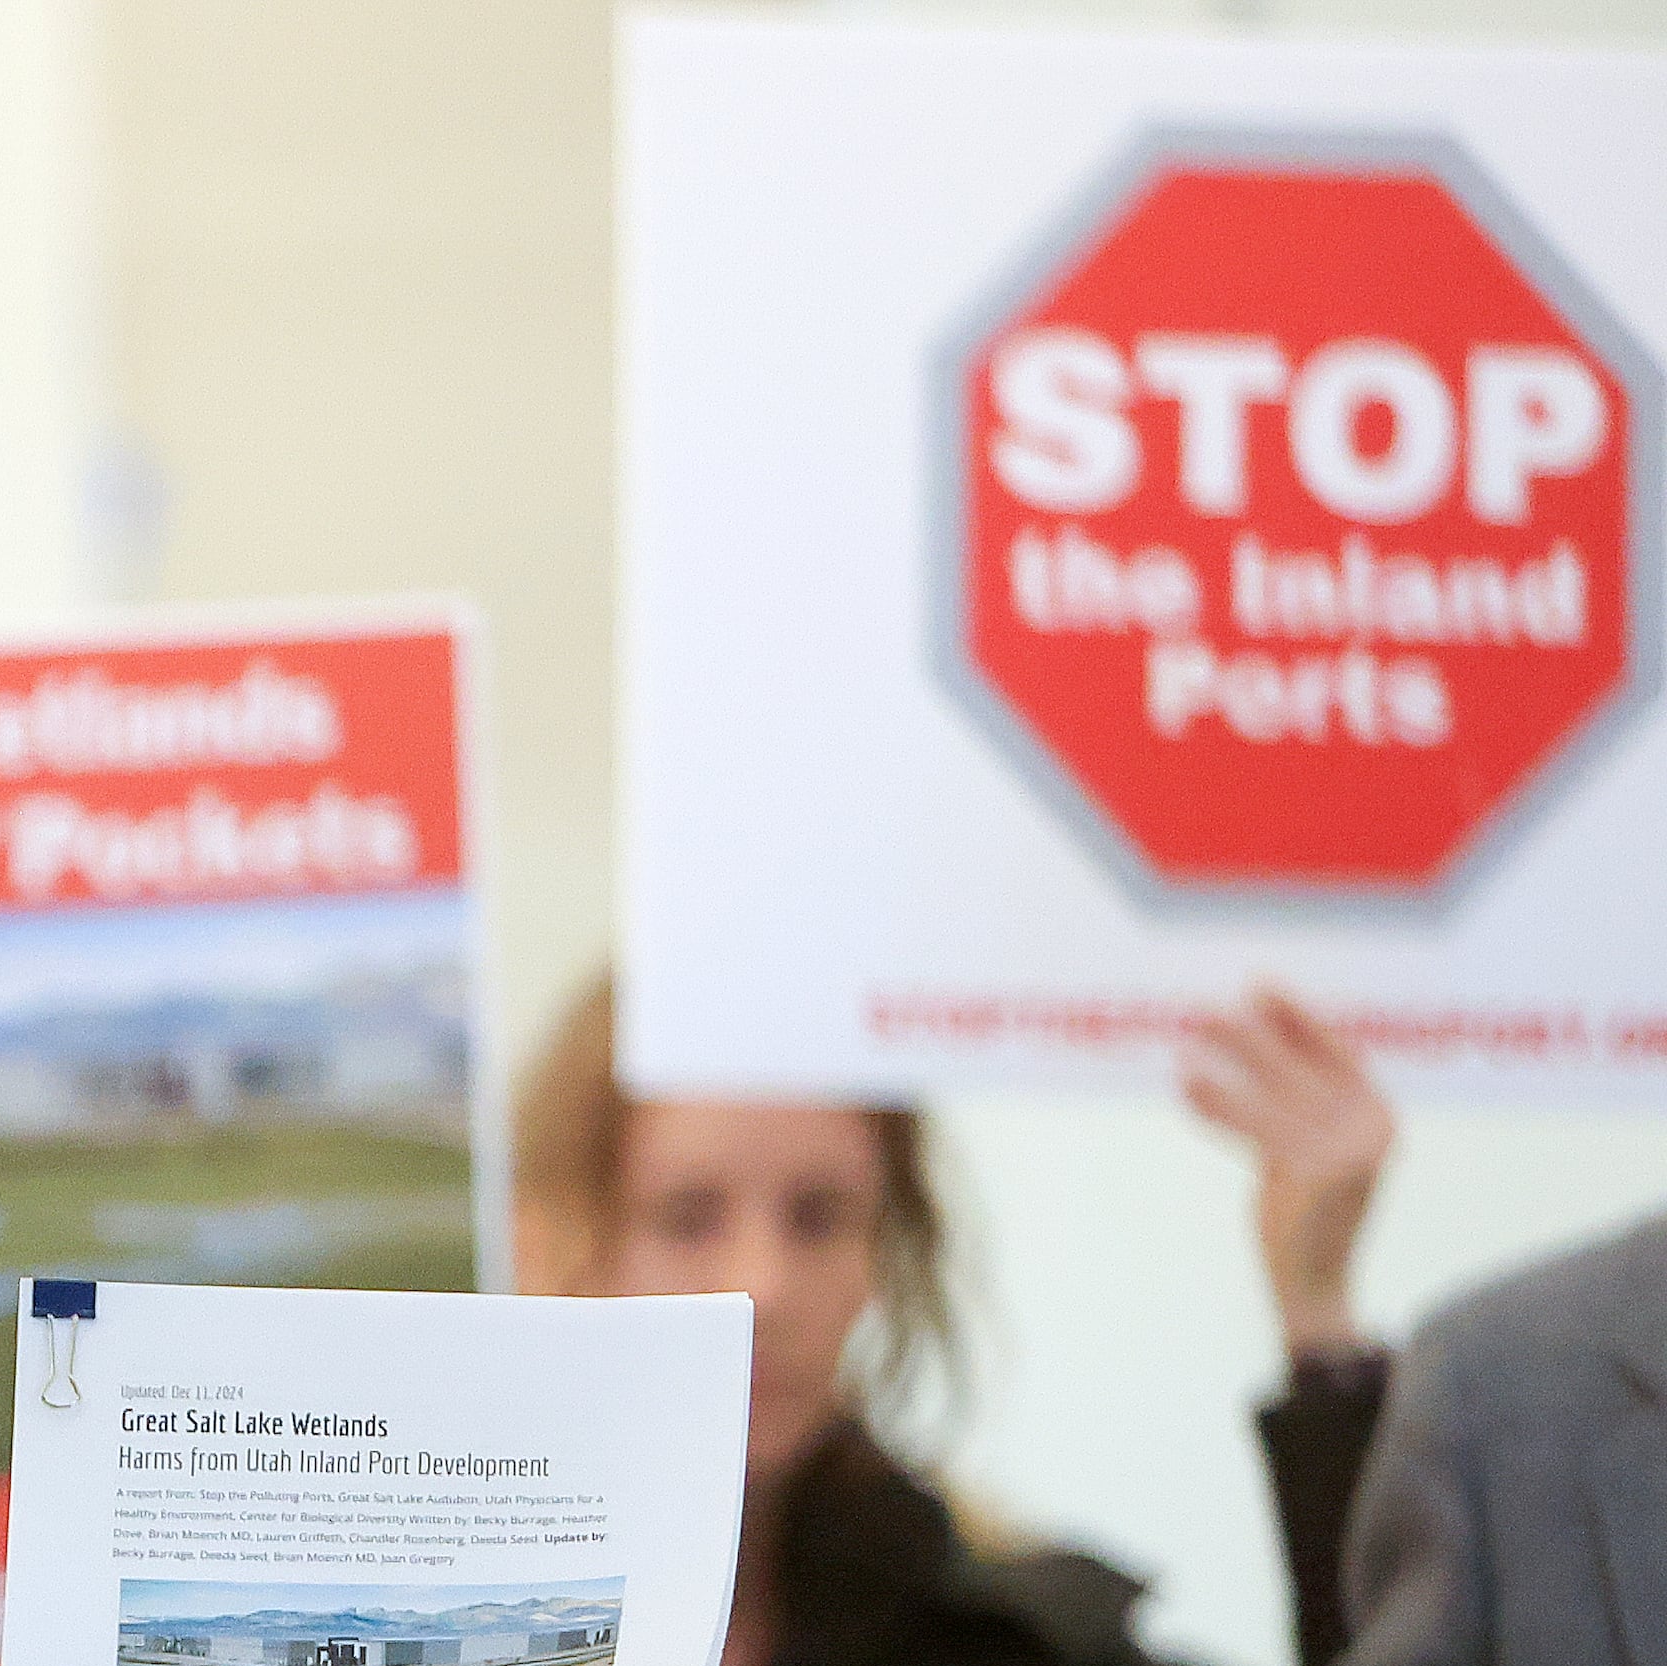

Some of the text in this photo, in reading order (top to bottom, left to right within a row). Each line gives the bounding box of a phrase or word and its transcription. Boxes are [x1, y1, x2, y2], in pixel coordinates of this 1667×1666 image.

[985, 325, 1612, 527] STOP
[1005, 525, 1589, 648] the Inland
[1142, 640, 1455, 750] Ports
[9, 778, 422, 906] Pockets
[122, 1408, 388, 1438] Great Salt Lake Wetlands
[119, 1446, 550, 1482] Harms from Utah Inland Port Development
[116, 1488, 124, 1497] A
[200, 1489, 225, 1502] Stop
[229, 1491, 247, 1500] the
[338, 1491, 370, 1503] Great
[397, 1493, 423, 1504] Lake
[115, 1508, 157, 1520] Healthy
[239, 1511, 277, 1522] Center
[281, 1511, 297, 1522] for
[544, 1532, 588, 1546] Update
